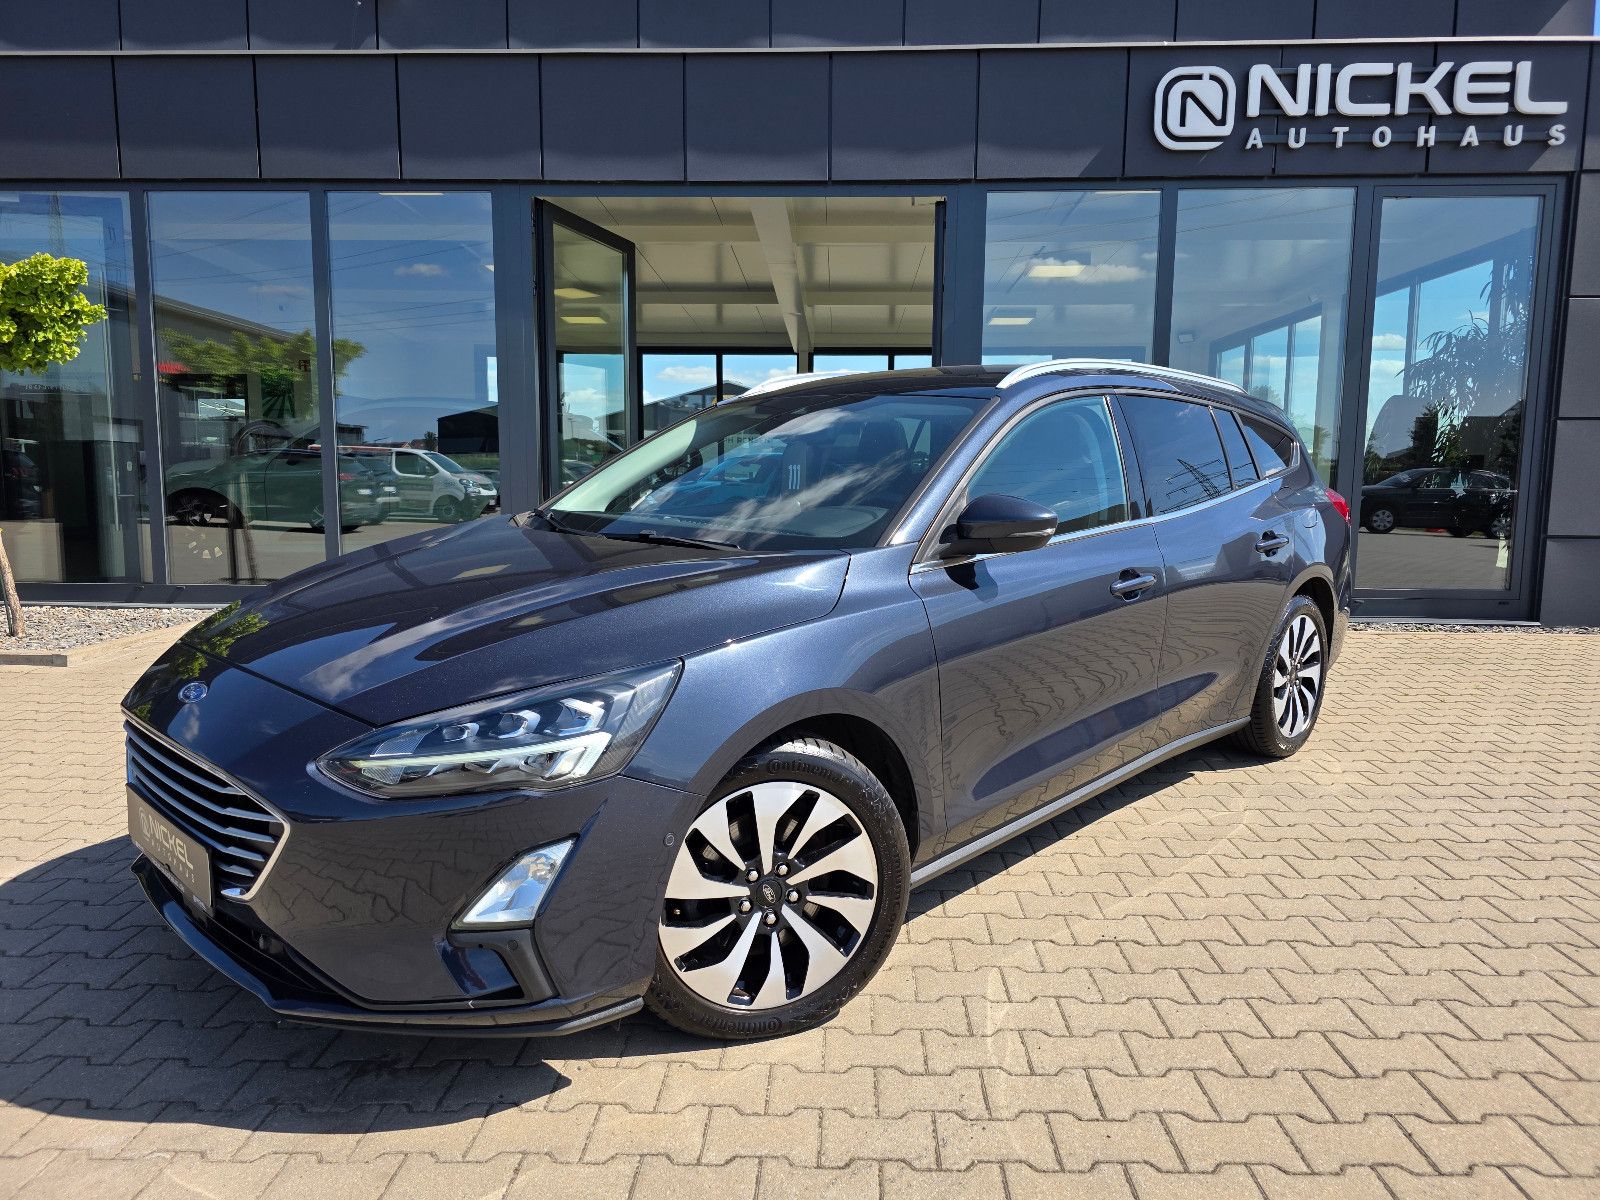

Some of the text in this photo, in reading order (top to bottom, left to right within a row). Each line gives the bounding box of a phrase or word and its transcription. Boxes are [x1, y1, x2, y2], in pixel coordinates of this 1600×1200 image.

[1246, 61, 1568, 118] NICKEL
[1245, 124, 1567, 150] AUTOHAUS
[148, 814, 194, 871] NICKEL
